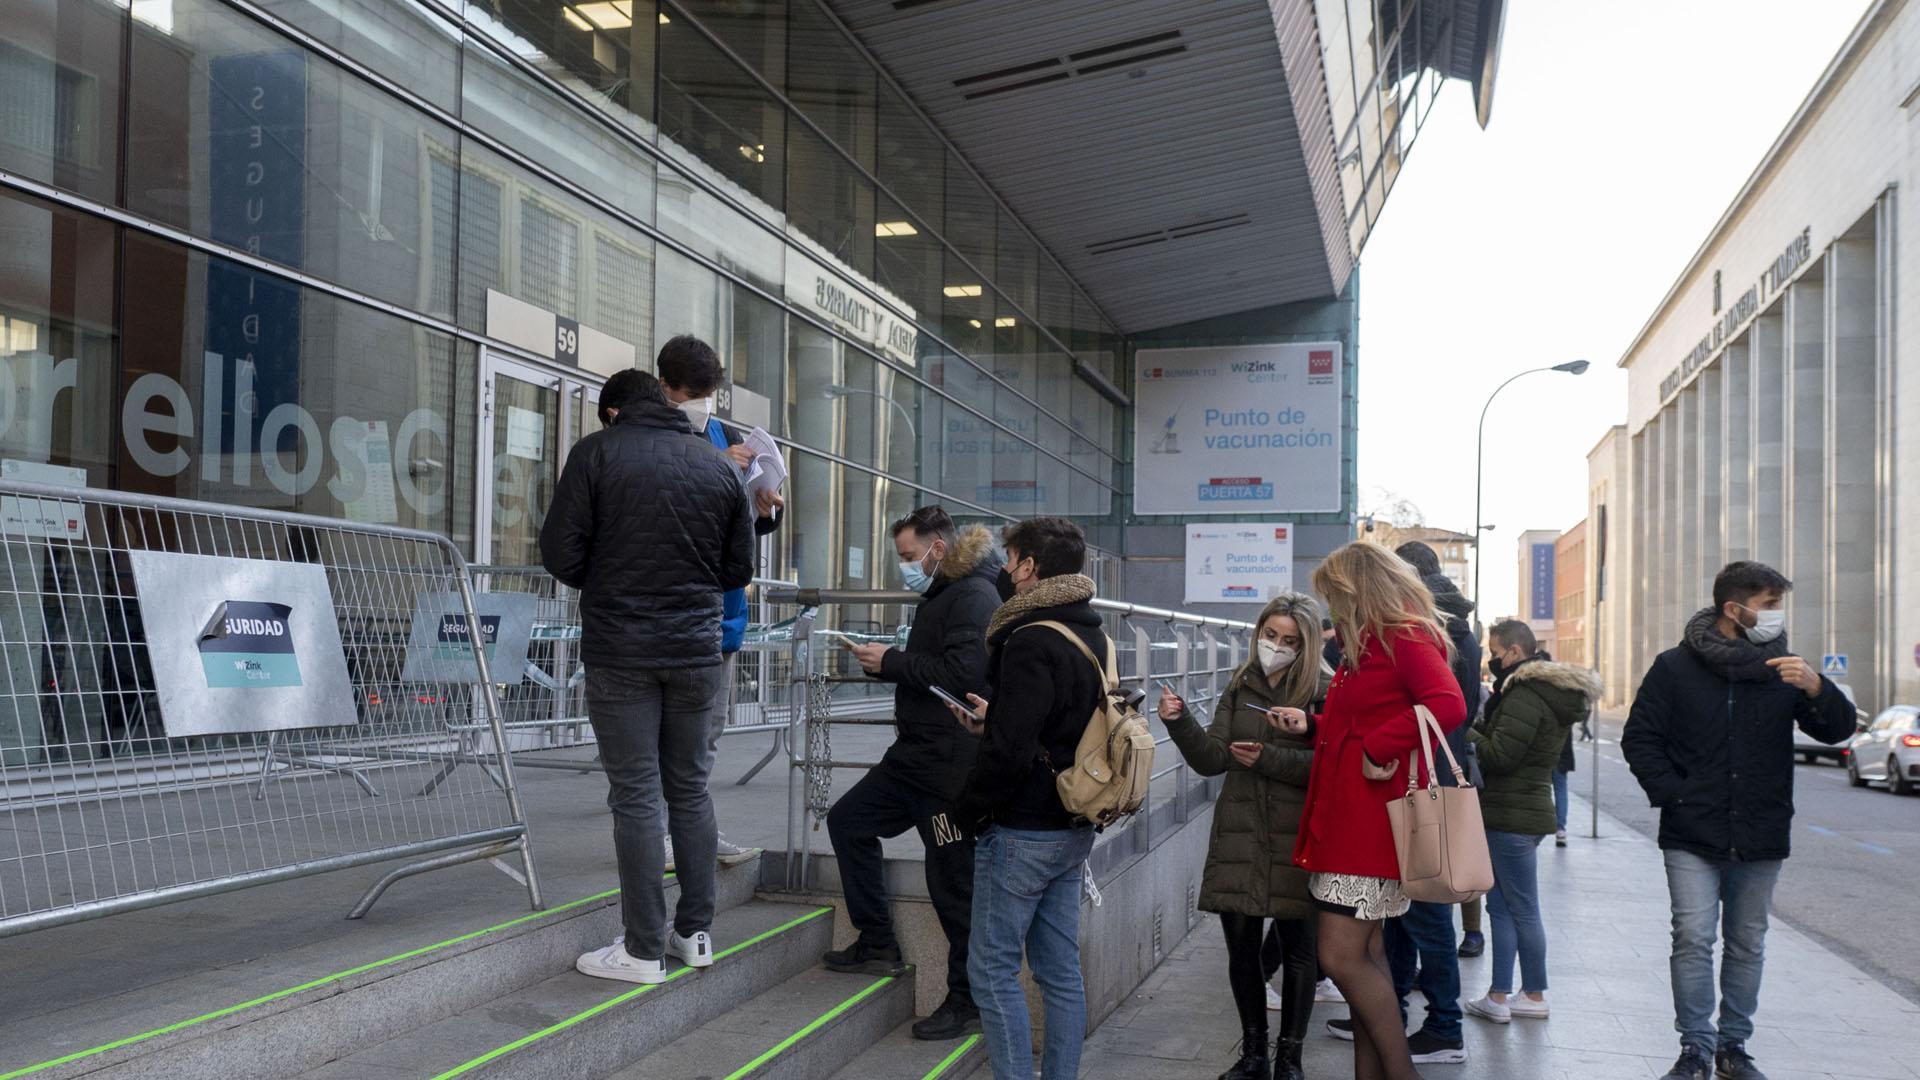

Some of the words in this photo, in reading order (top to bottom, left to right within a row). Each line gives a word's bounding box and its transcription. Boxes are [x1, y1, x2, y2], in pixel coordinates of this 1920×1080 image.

[558, 327, 577, 355] 59
[718, 391, 731, 411] 58
[1205, 409, 1270, 427] Punto
[1278, 407, 1306, 425] de
[1204, 427, 1333, 449] vacunación
[1200, 485, 1253, 499] PUERTA
[1226, 553, 1258, 562] Punto
[1261, 553, 1274, 562] de
[443, 623, 495, 634] SEGUAD
[235, 660, 262, 671] WiZink
